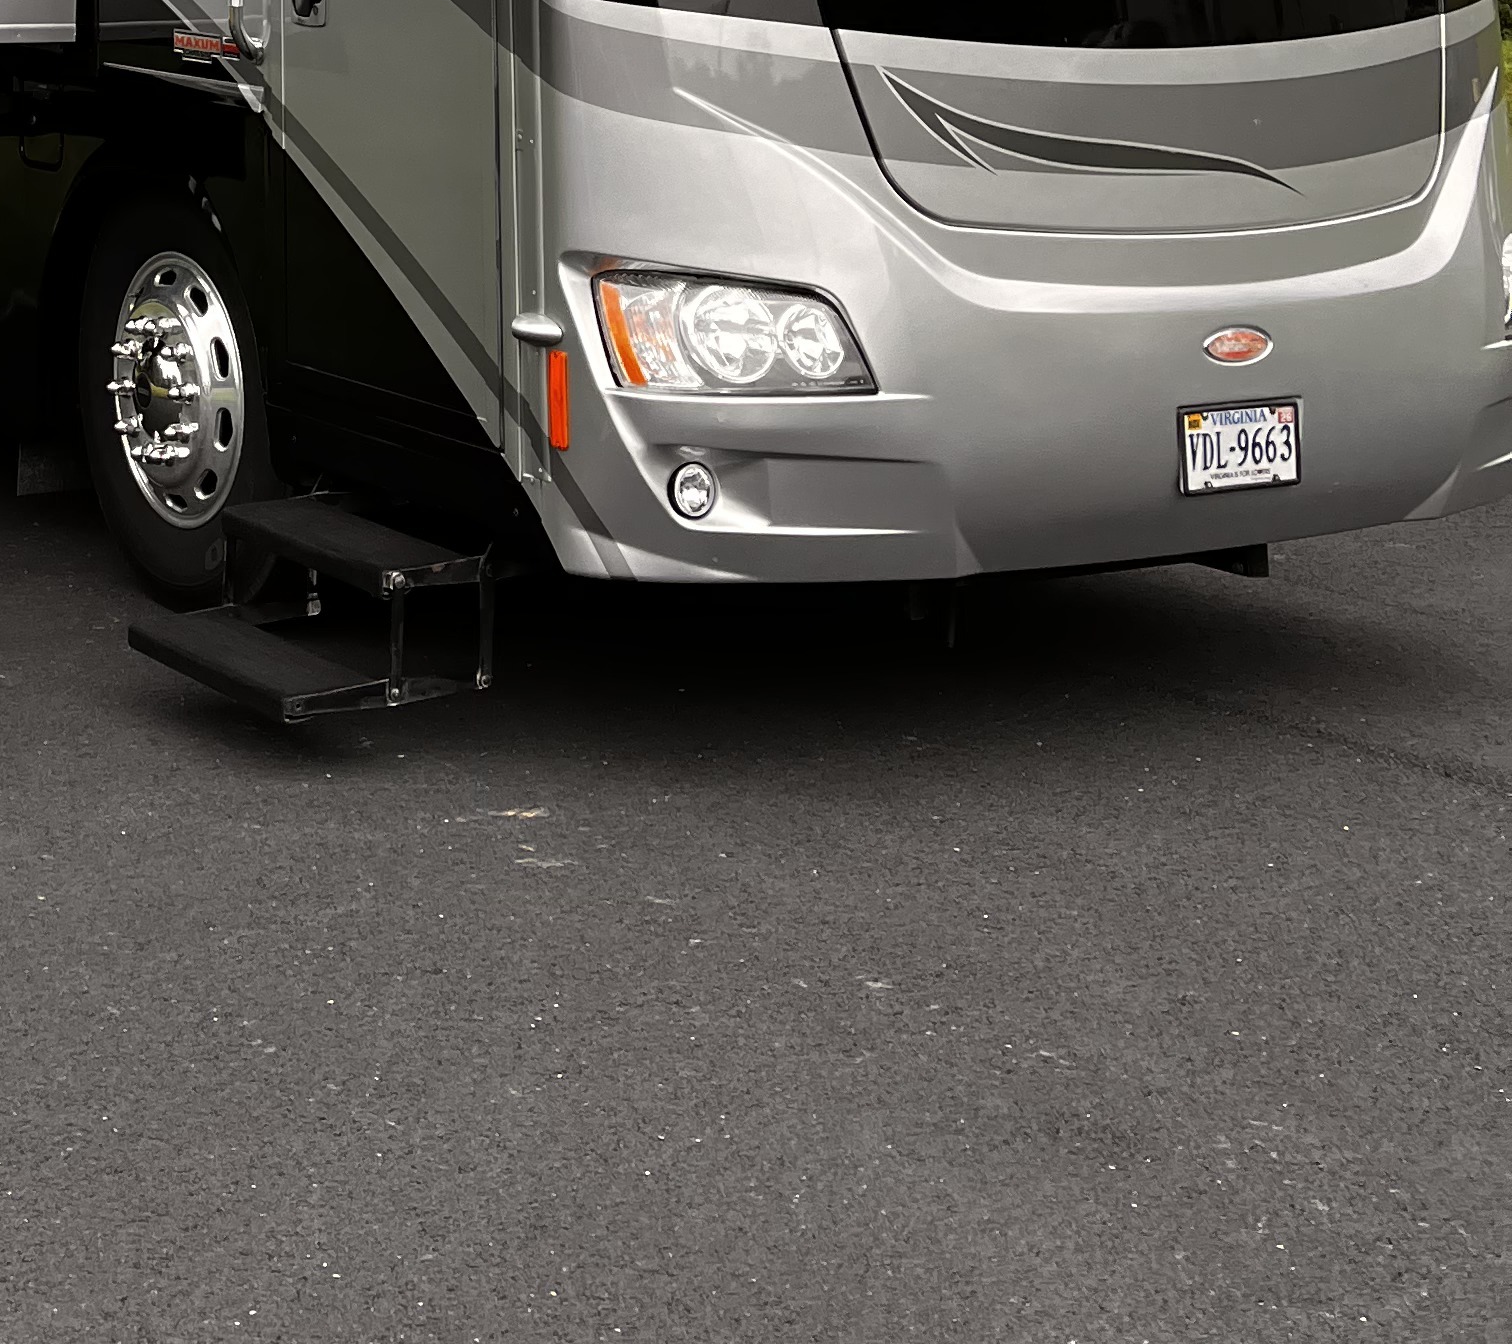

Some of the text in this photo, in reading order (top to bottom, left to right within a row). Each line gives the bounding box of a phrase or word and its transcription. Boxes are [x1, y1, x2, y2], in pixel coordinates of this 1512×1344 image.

[174, 35, 220, 51] MAXUM
[1210, 408, 1267, 426] VIRGINIA
[1188, 424, 1292, 471] VDL-9663
